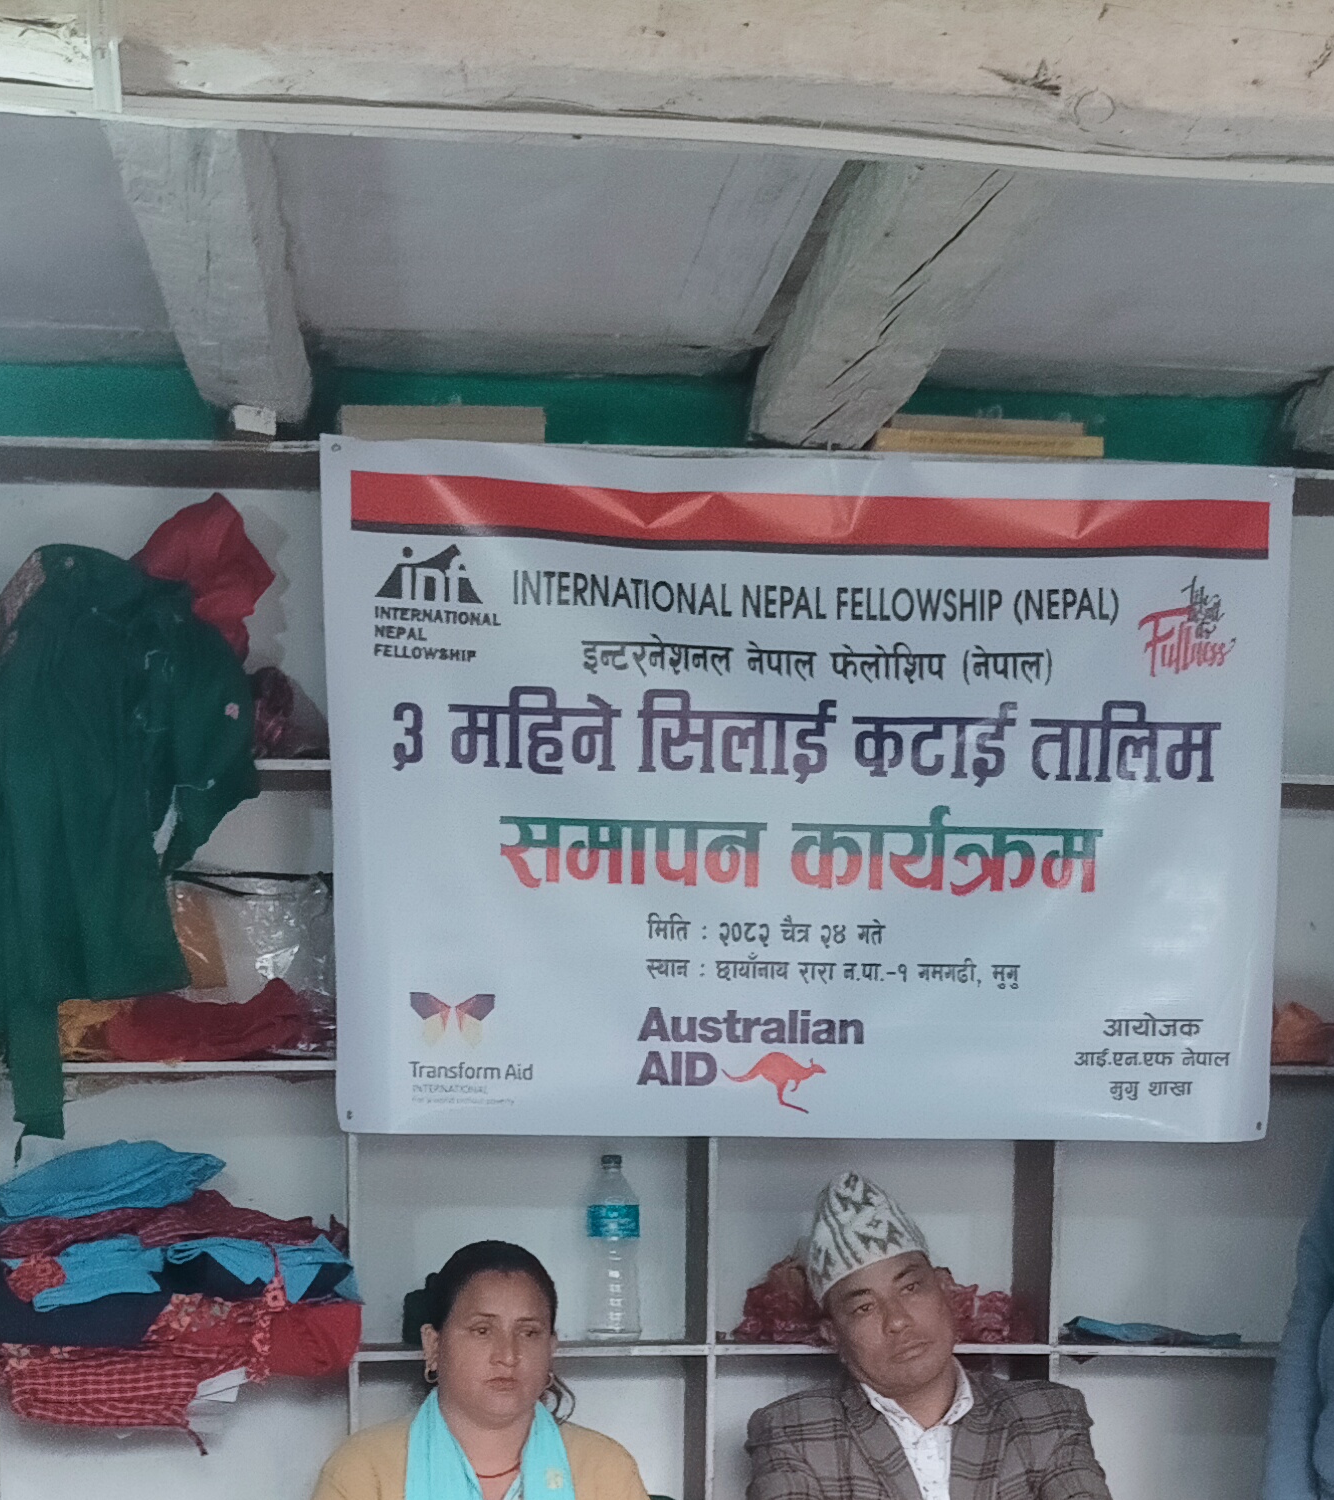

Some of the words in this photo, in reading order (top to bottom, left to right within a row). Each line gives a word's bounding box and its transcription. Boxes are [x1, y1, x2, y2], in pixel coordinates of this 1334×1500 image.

[513, 569, 732, 617] INTERNATIONAL
[742, 585, 827, 619] NEPAL
[836, 587, 1003, 622] FELLOWSHIP
[1013, 587, 1119, 626] (NEPAL)
[374, 606, 501, 626] INTERNATIONAL
[374, 625, 427, 642] NEPAL
[374, 643, 477, 662] FELLOWSHIP
[581, 633, 735, 676] इन्टरनेशनल
[746, 641, 817, 681] नेपाल
[829, 642, 946, 685] फेलोशिप
[963, 644, 1053, 686] (नेपाल)
[392, 702, 424, 773] ३
[448, 686, 621, 775] महिने
[637, 688, 837, 785] सिलाई
[852, 700, 1017, 788] कटाई
[1030, 699, 1221, 783] तालिम
[499, 815, 767, 889] समापन
[789, 805, 1104, 896] कार्यक्रम
[646, 912, 691, 941] मिति
[719, 922, 771, 948] २०८२
[779, 914, 812, 943] चैत्र
[820, 923, 847, 949] २४
[645, 958, 690, 980] स्थान
[798, 962, 837, 985] रारा
[636, 1006, 865, 1045] Australian
[1103, 1011, 1205, 1038] आयोजक
[408, 1060, 501, 1080] Transform
[504, 1063, 534, 1081] Aid
[636, 1050, 718, 1087] AID
[1073, 1047, 1176, 1068] आई.एन.एफ
[1181, 1047, 1232, 1067] नेपाल
[1108, 1080, 1141, 1101] मुगु
[1147, 1080, 1194, 1097] शाखा
